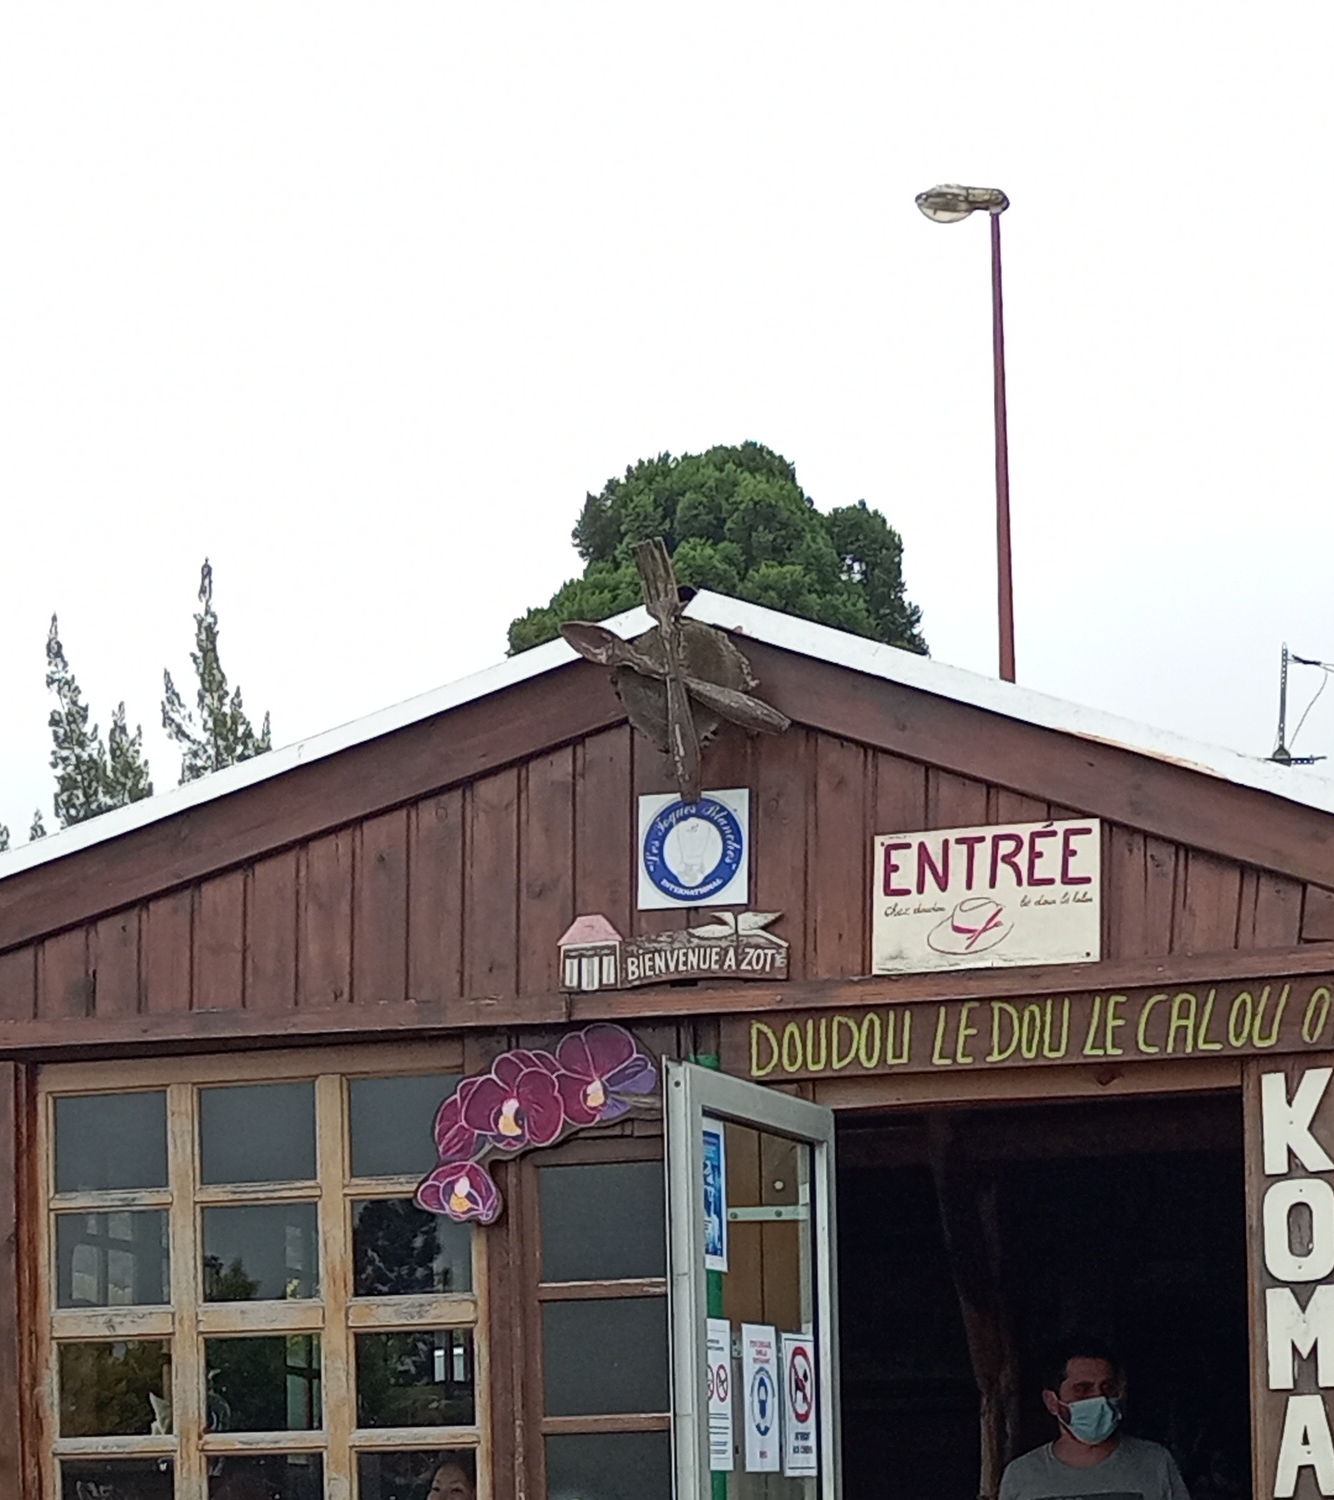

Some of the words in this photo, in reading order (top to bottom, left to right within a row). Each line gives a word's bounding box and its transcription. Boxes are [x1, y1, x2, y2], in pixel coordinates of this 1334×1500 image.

[883, 820, 1093, 897] ENTRÉE
[660, 878, 724, 897] INTERNATIONAL
[627, 947, 720, 980] BIENVENUE
[723, 949, 737, 971] A
[740, 947, 777, 974] ZOT
[750, 1008, 912, 1078] DOUDOU
[931, 1001, 980, 1065] LE
[985, 996, 1071, 1063] DOU
[1082, 994, 1128, 1056] LE
[1136, 982, 1291, 1054] CALOU
